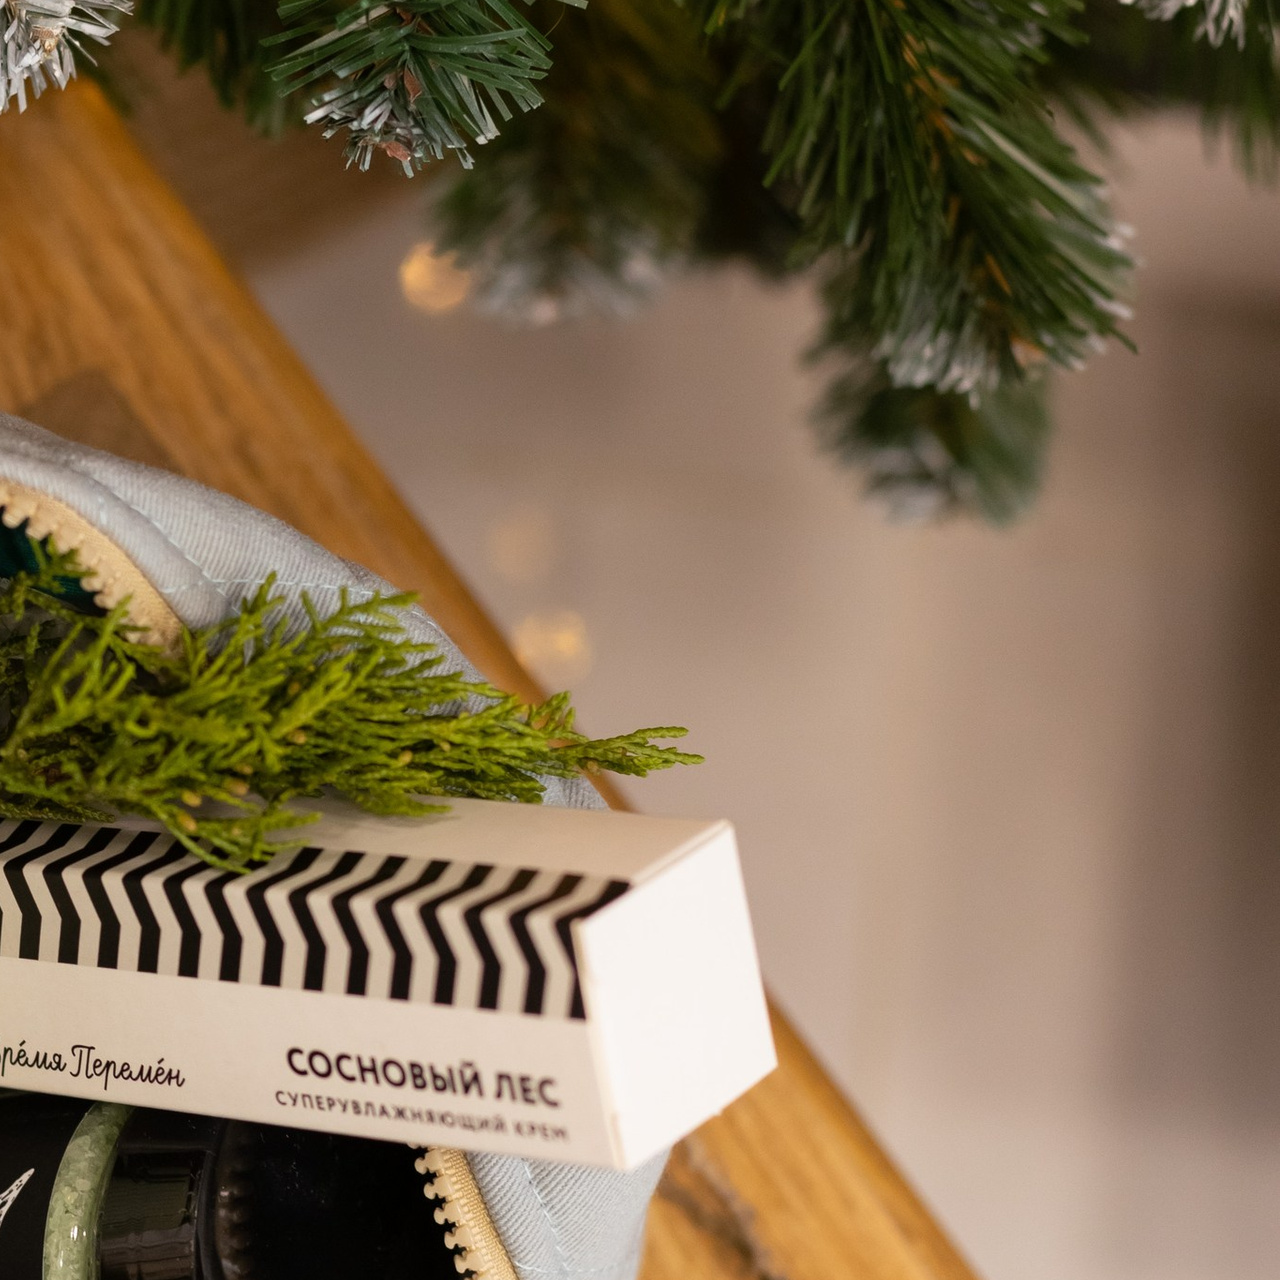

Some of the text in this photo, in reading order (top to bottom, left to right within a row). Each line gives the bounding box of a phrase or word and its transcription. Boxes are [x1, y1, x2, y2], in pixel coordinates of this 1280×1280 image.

[286, 1047, 560, 1108] СОСНОВЫЙ ЛЕС
[275, 1090, 507, 1134] СУПЕРУВЛАЖНЯЮЩИЙ
